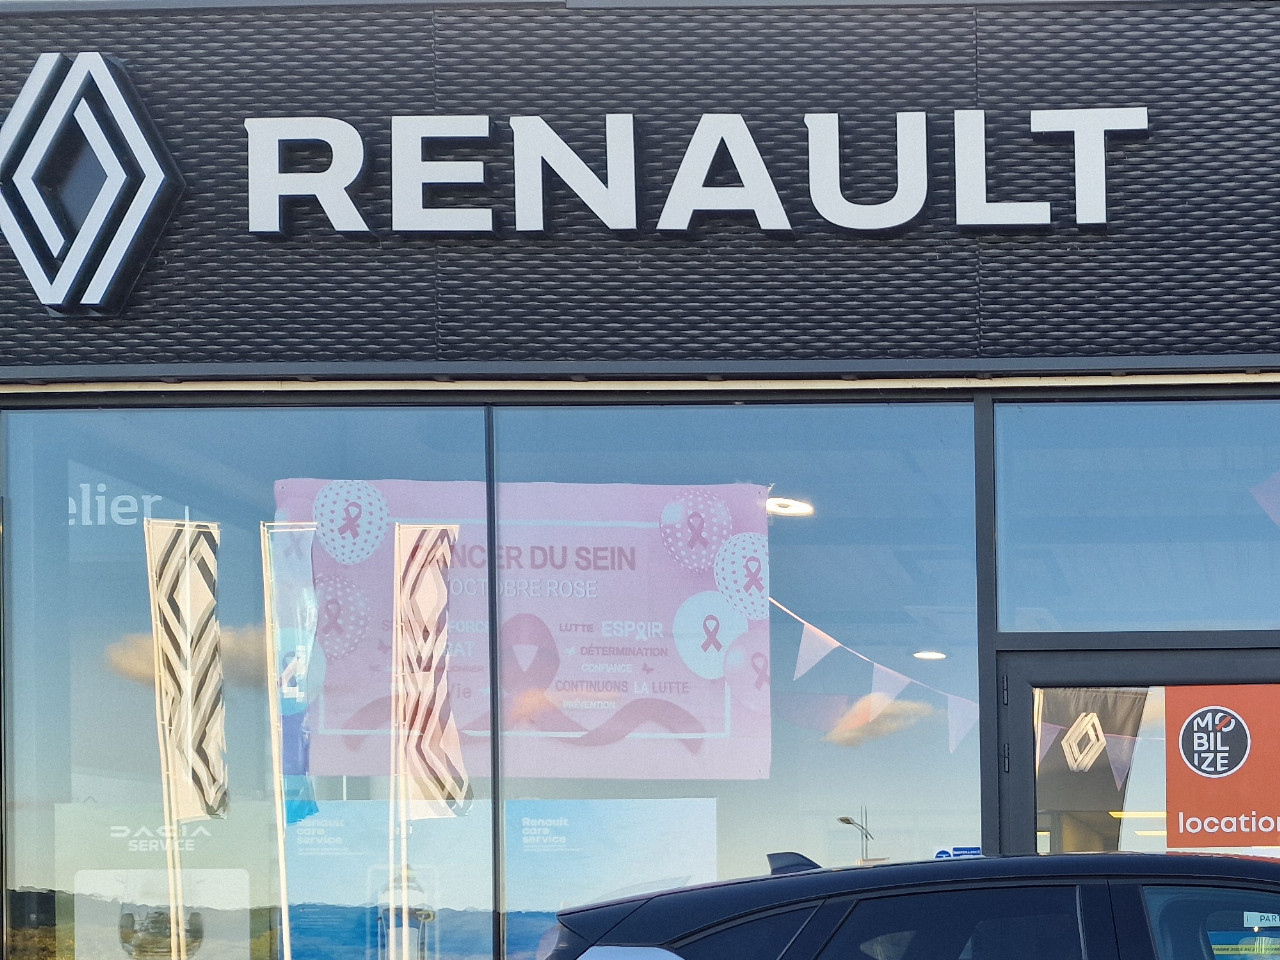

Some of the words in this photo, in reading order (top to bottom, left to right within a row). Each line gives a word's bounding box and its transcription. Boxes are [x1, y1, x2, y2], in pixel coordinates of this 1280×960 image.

[244, 107, 1149, 234] RENAULT
[530, 546, 567, 570] DU
[574, 546, 636, 571] SEIN
[546, 579, 598, 598] ROSE
[559, 623, 595, 633] LUTTE
[580, 645, 668, 657] DÉTERMINATION
[581, 663, 633, 673] CONFIANCE
[555, 680, 628, 693] CONTINUONS
[634, 682, 649, 693] LA
[652, 681, 690, 693] LUTTE
[1193, 733, 1229, 751] BIL
[1193, 753, 1229, 772] IZE
[522, 816, 569, 826] Renault
[110, 825, 212, 838] DACIA
[522, 827, 550, 835] care
[128, 839, 195, 852] SERVCE
[522, 835, 567, 844] service
